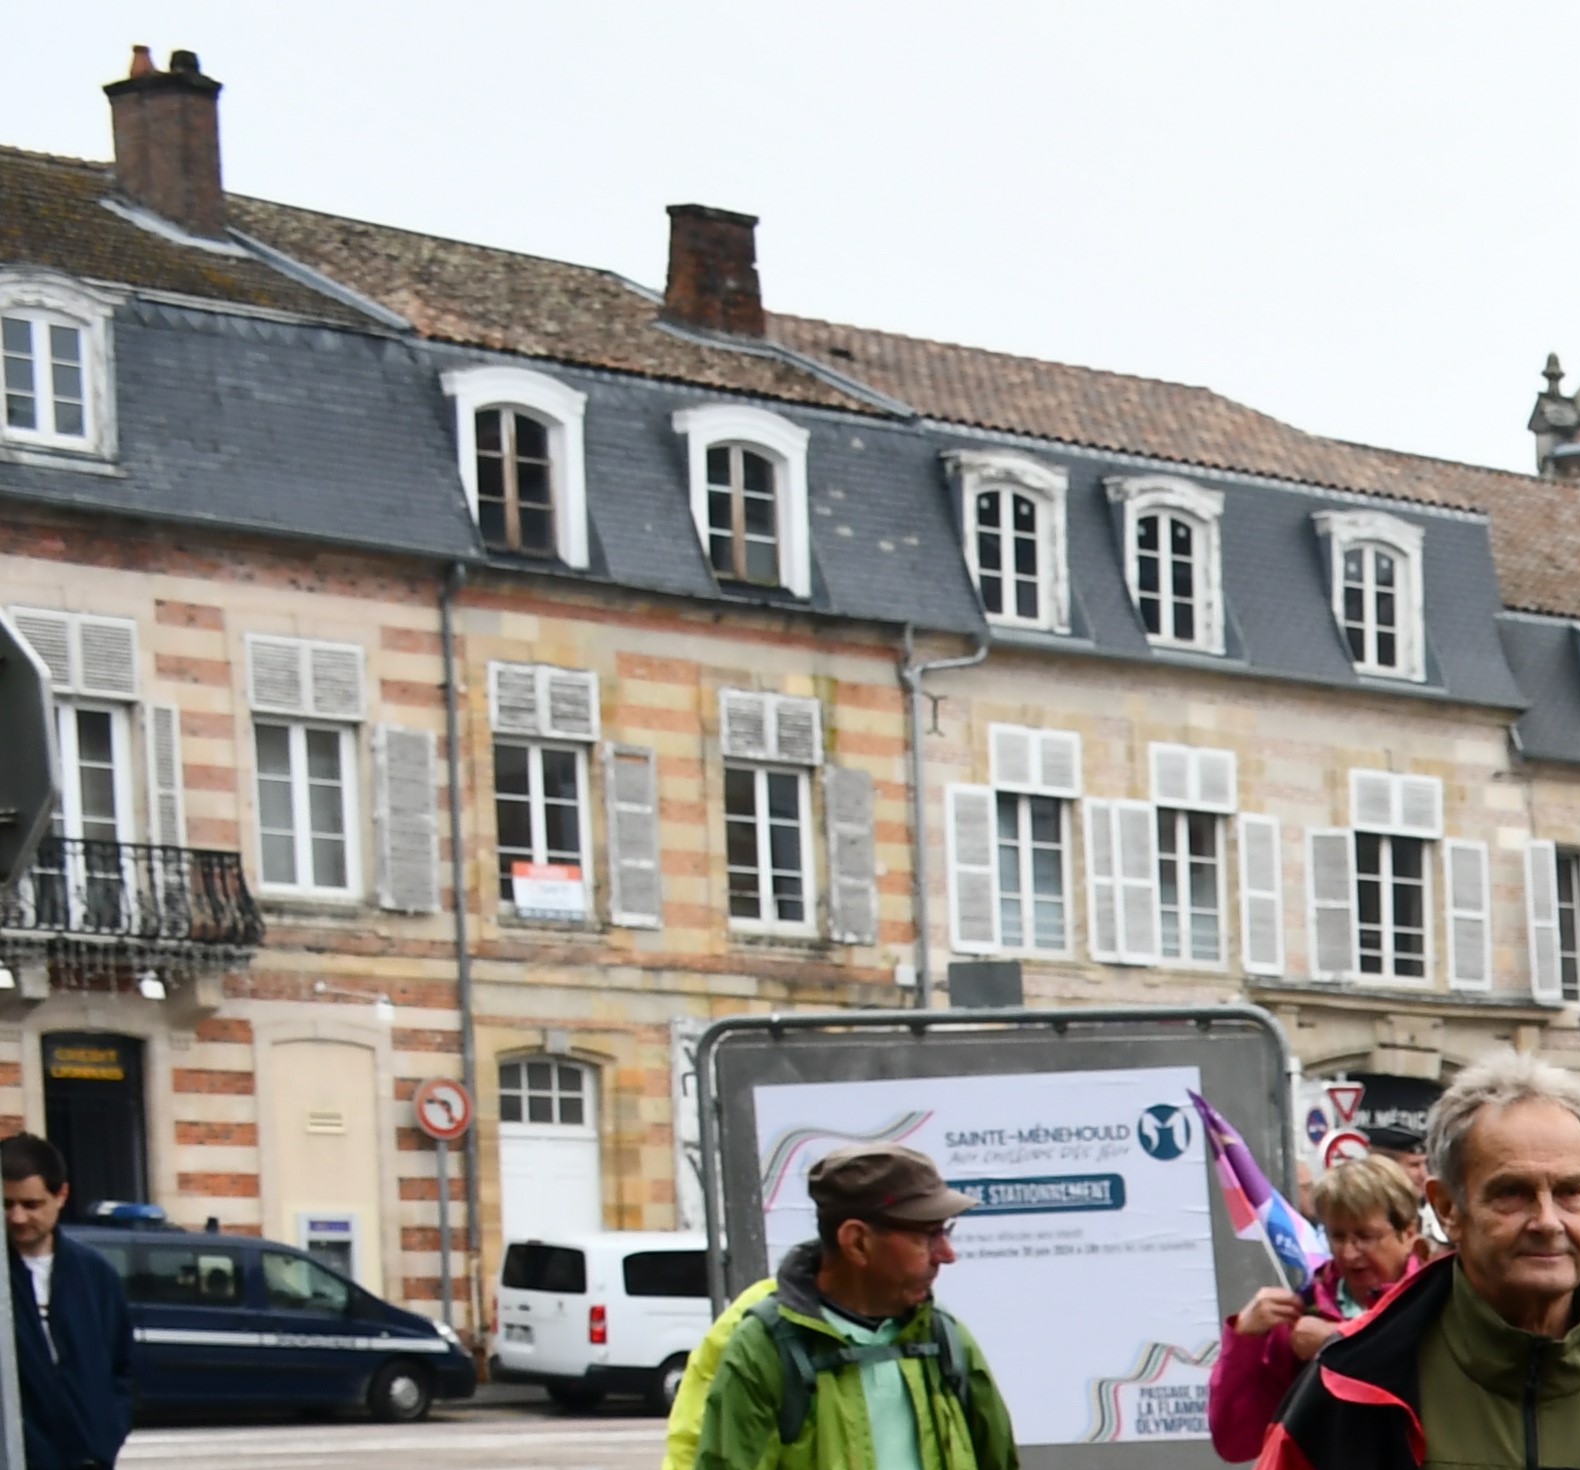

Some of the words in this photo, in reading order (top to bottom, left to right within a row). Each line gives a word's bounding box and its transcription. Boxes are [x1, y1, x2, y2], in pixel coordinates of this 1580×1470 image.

[944, 1122, 1130, 1148] SAINTE-MÉNEHOULD
[988, 1180, 1111, 1204] STATIONNEMENT
[1159, 1400, 1208, 1415] FLAMM
